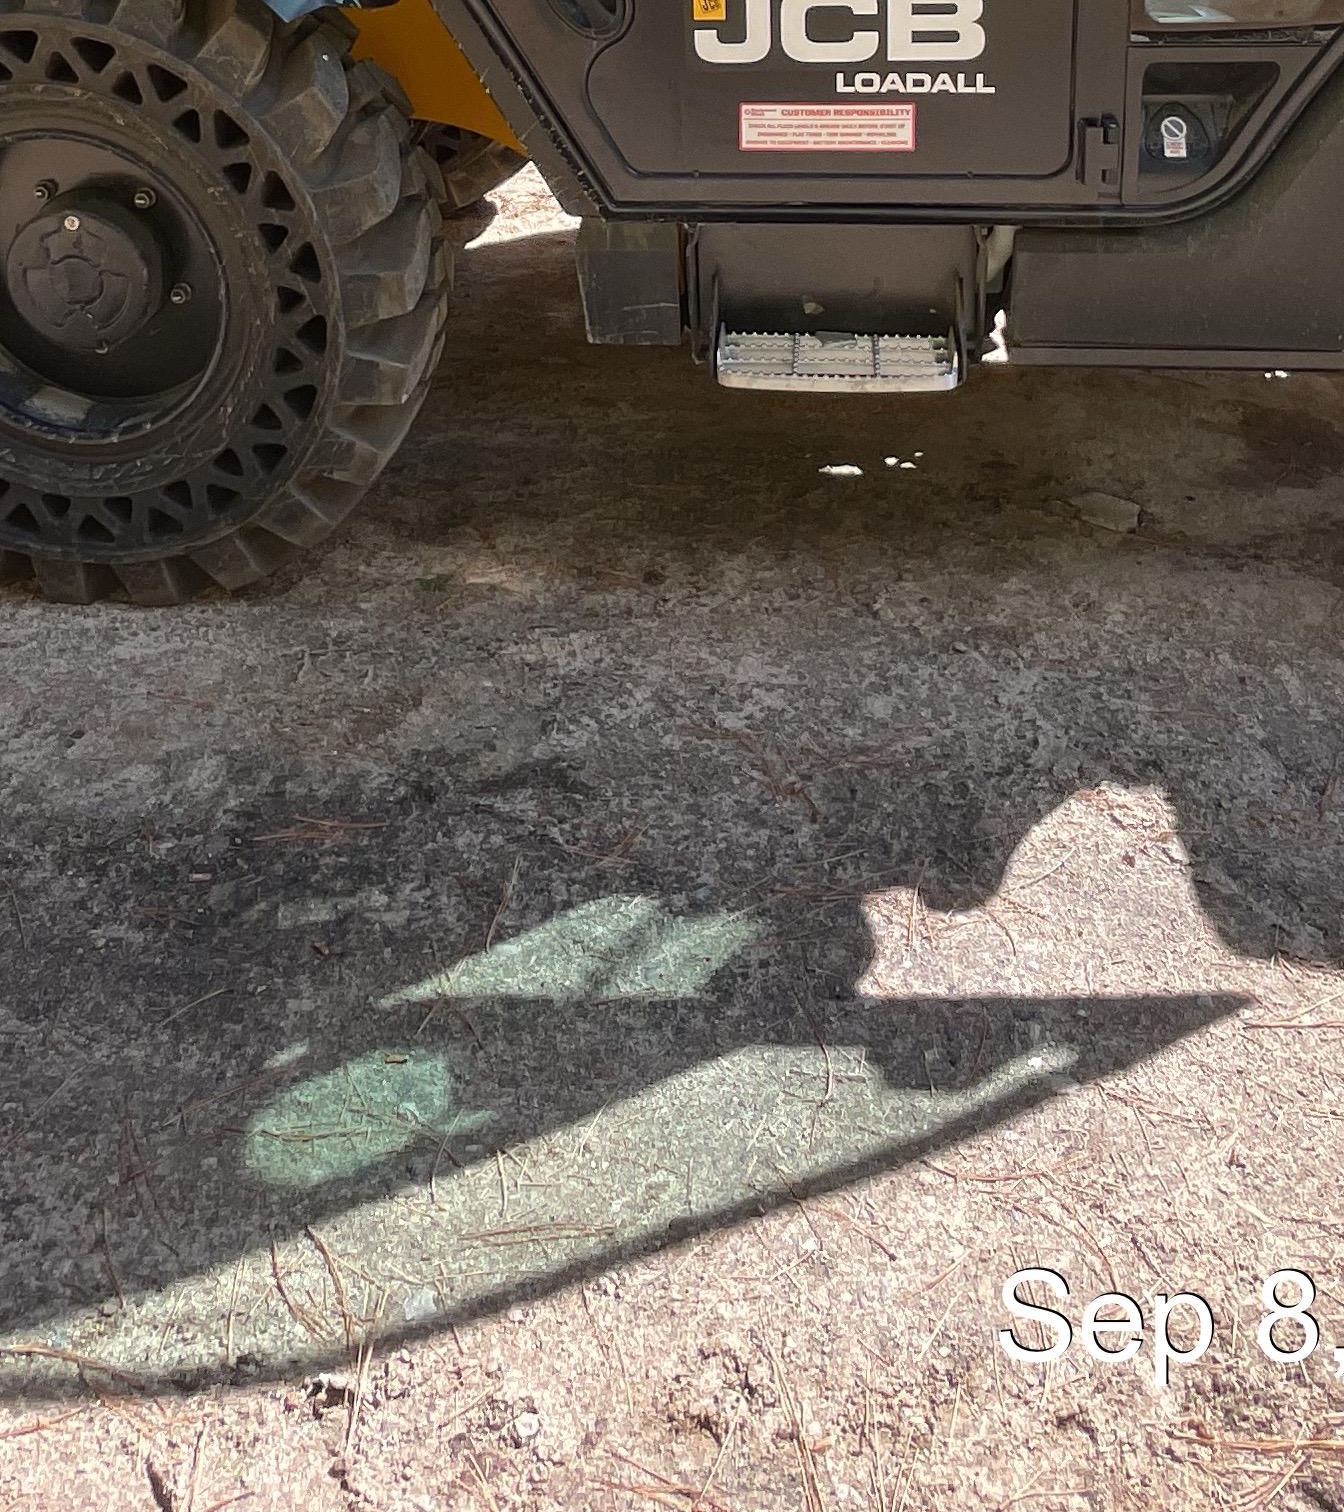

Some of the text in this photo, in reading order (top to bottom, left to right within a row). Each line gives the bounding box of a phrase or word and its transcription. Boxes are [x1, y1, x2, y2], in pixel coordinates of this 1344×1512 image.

[835, 72, 996, 94] LOADALL
[780, 108, 832, 117] CUSTOMER
[833, 108, 911, 117] RESPONSIBILITY
